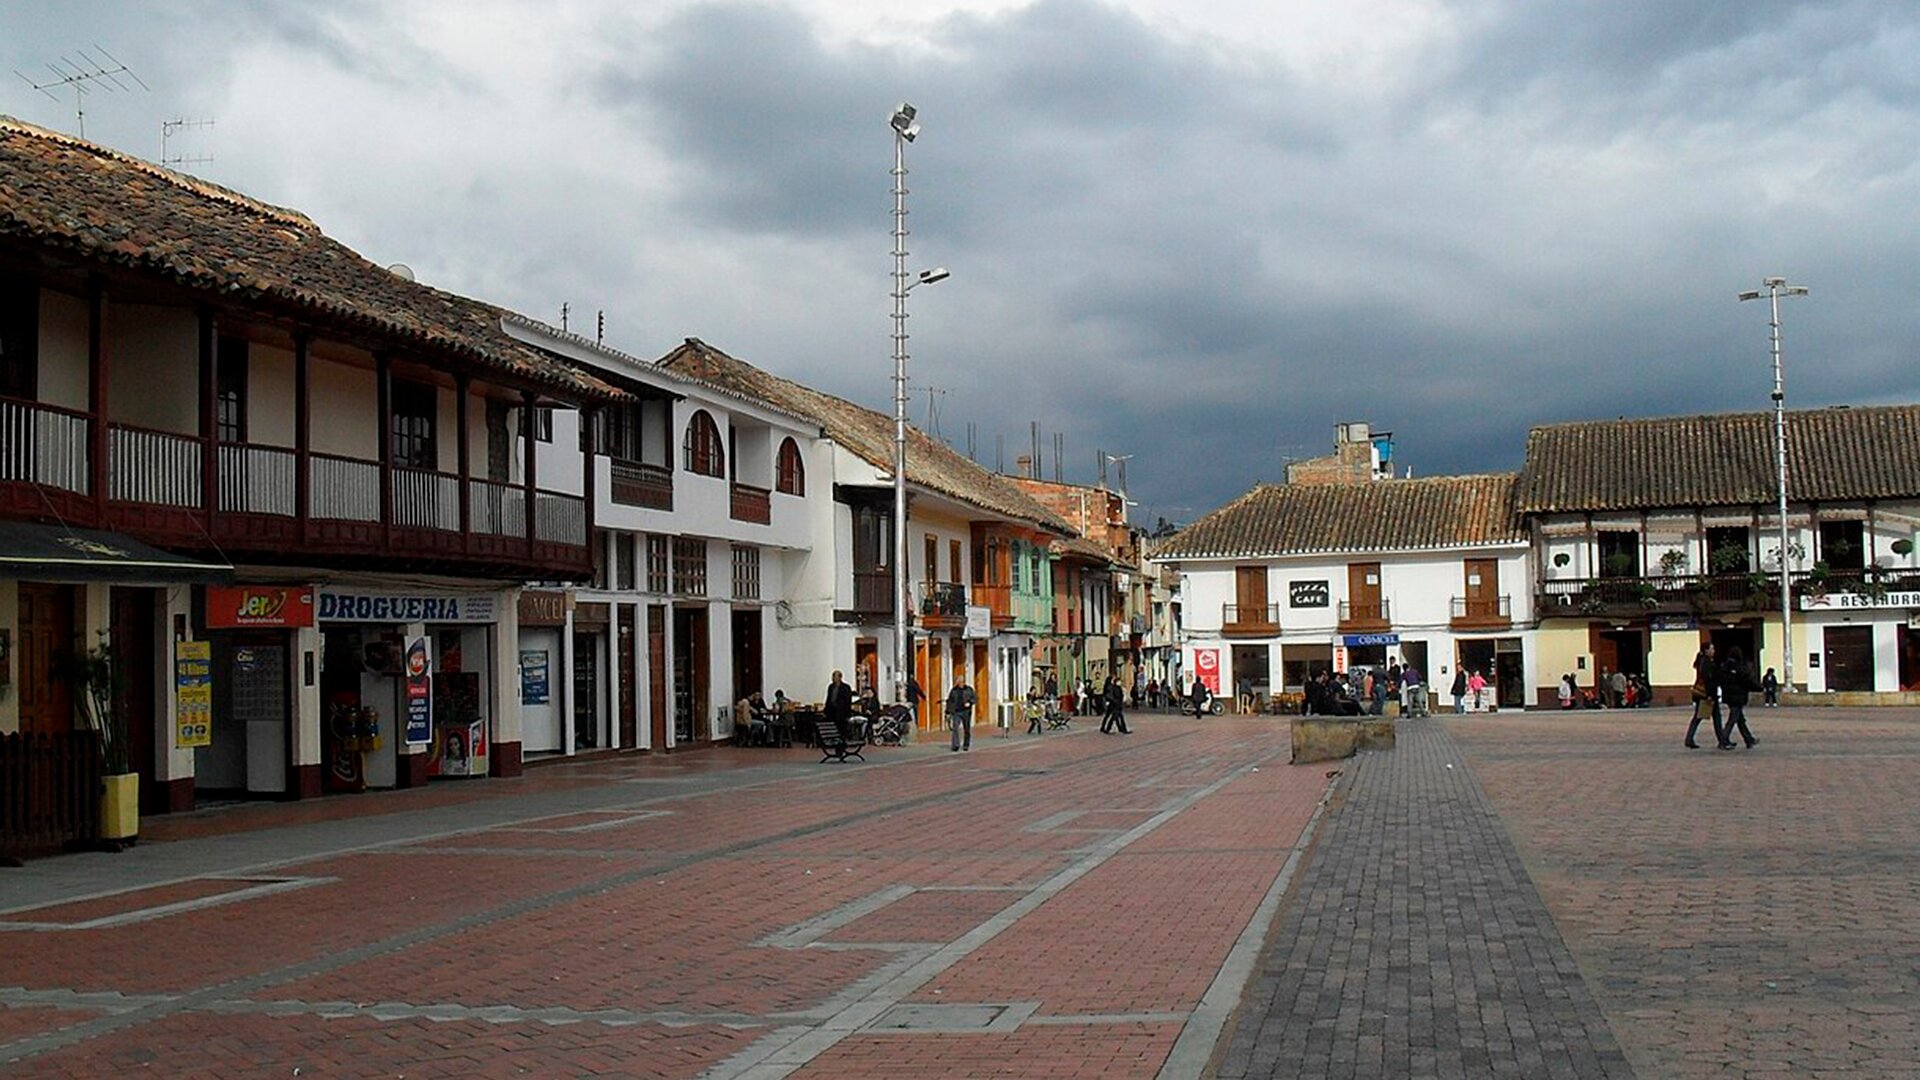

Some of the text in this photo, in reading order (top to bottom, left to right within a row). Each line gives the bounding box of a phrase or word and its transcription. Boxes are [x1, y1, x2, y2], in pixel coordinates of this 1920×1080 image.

[1291, 584, 1327, 596] PIZZA
[1295, 595, 1324, 604] CAFE
[318, 594, 459, 619] DROGUERIA
